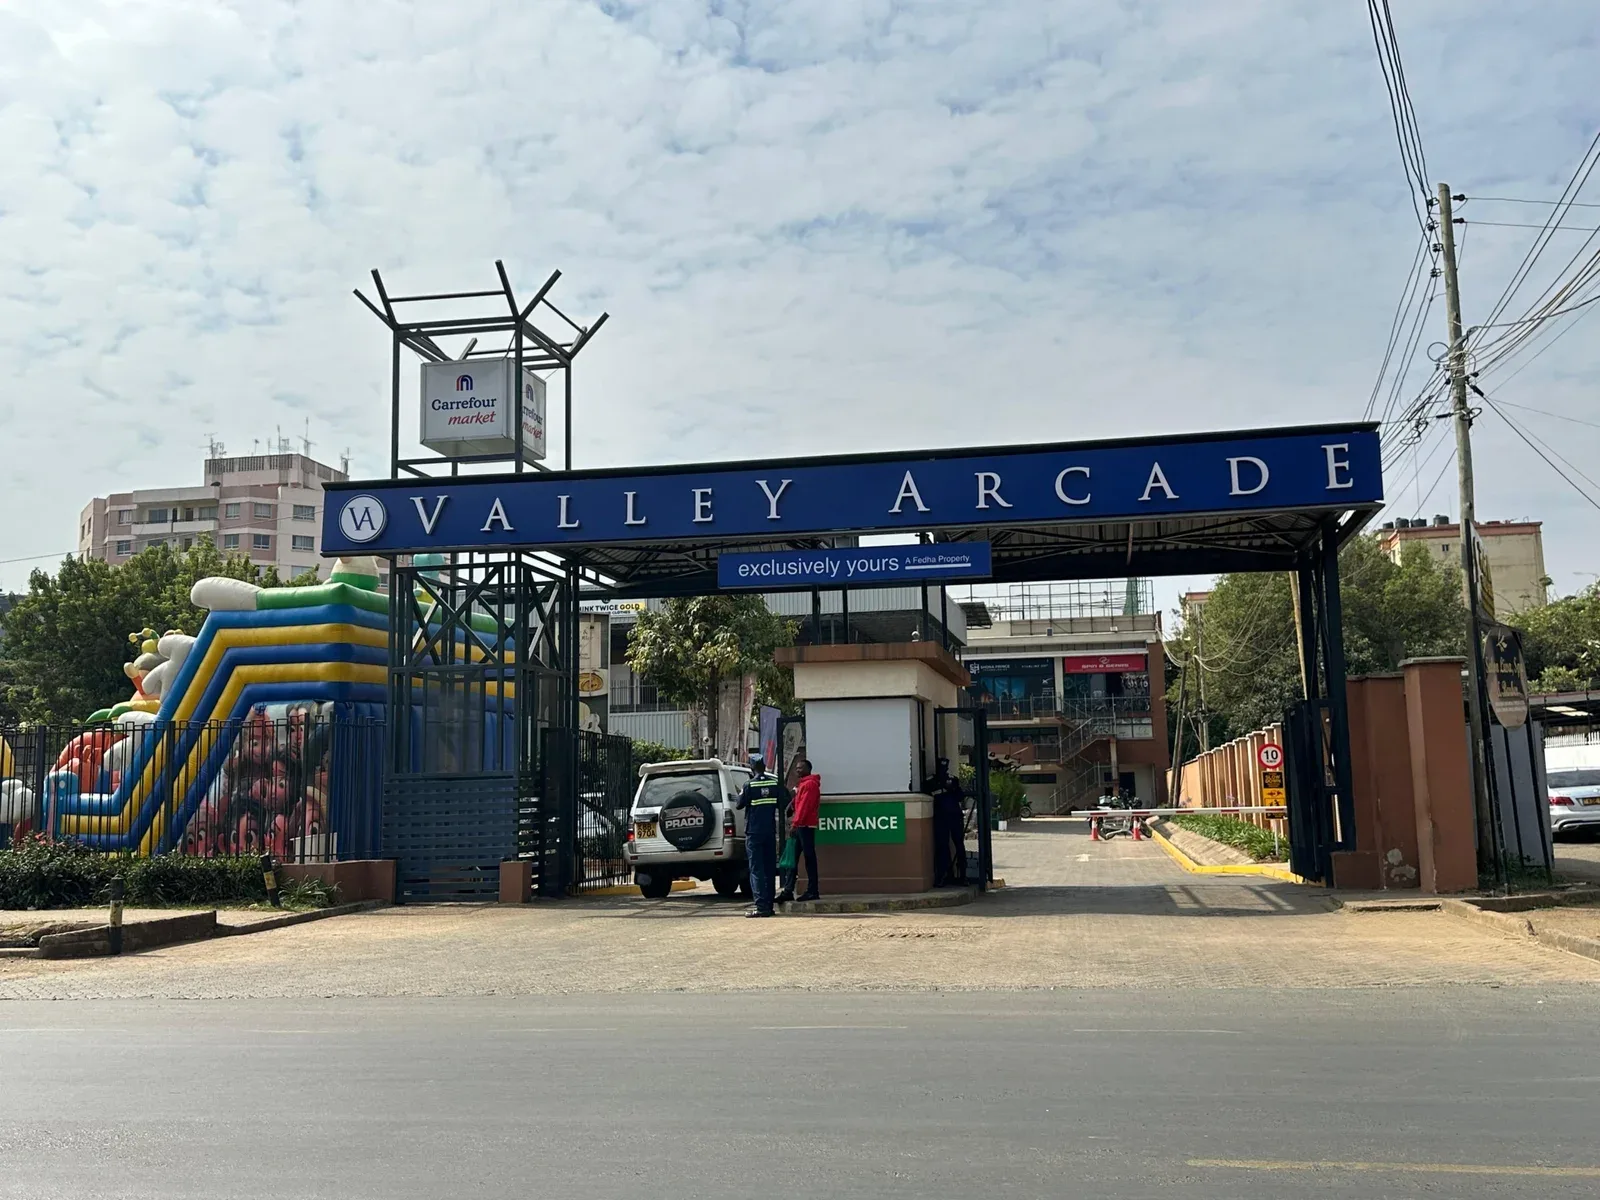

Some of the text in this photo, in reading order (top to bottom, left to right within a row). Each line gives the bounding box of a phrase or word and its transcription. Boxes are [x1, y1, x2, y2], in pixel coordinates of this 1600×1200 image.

[431, 397, 497, 411] Carrefour
[447, 410, 497, 425] market
[522, 405, 543, 425] rrefour
[522, 421, 543, 440] market
[410, 443, 1354, 535] VALLEY ARCADE
[912, 555, 936, 564] Fedha
[938, 554, 970, 563] Property
[738, 556, 899, 577] exclusively yours
[595, 604, 618, 612] TWICE
[1264, 750, 1278, 760] 10
[665, 817, 704, 829] PRADO
[818, 816, 898, 830] ENTRANCE
[637, 830, 656, 838] 970A
